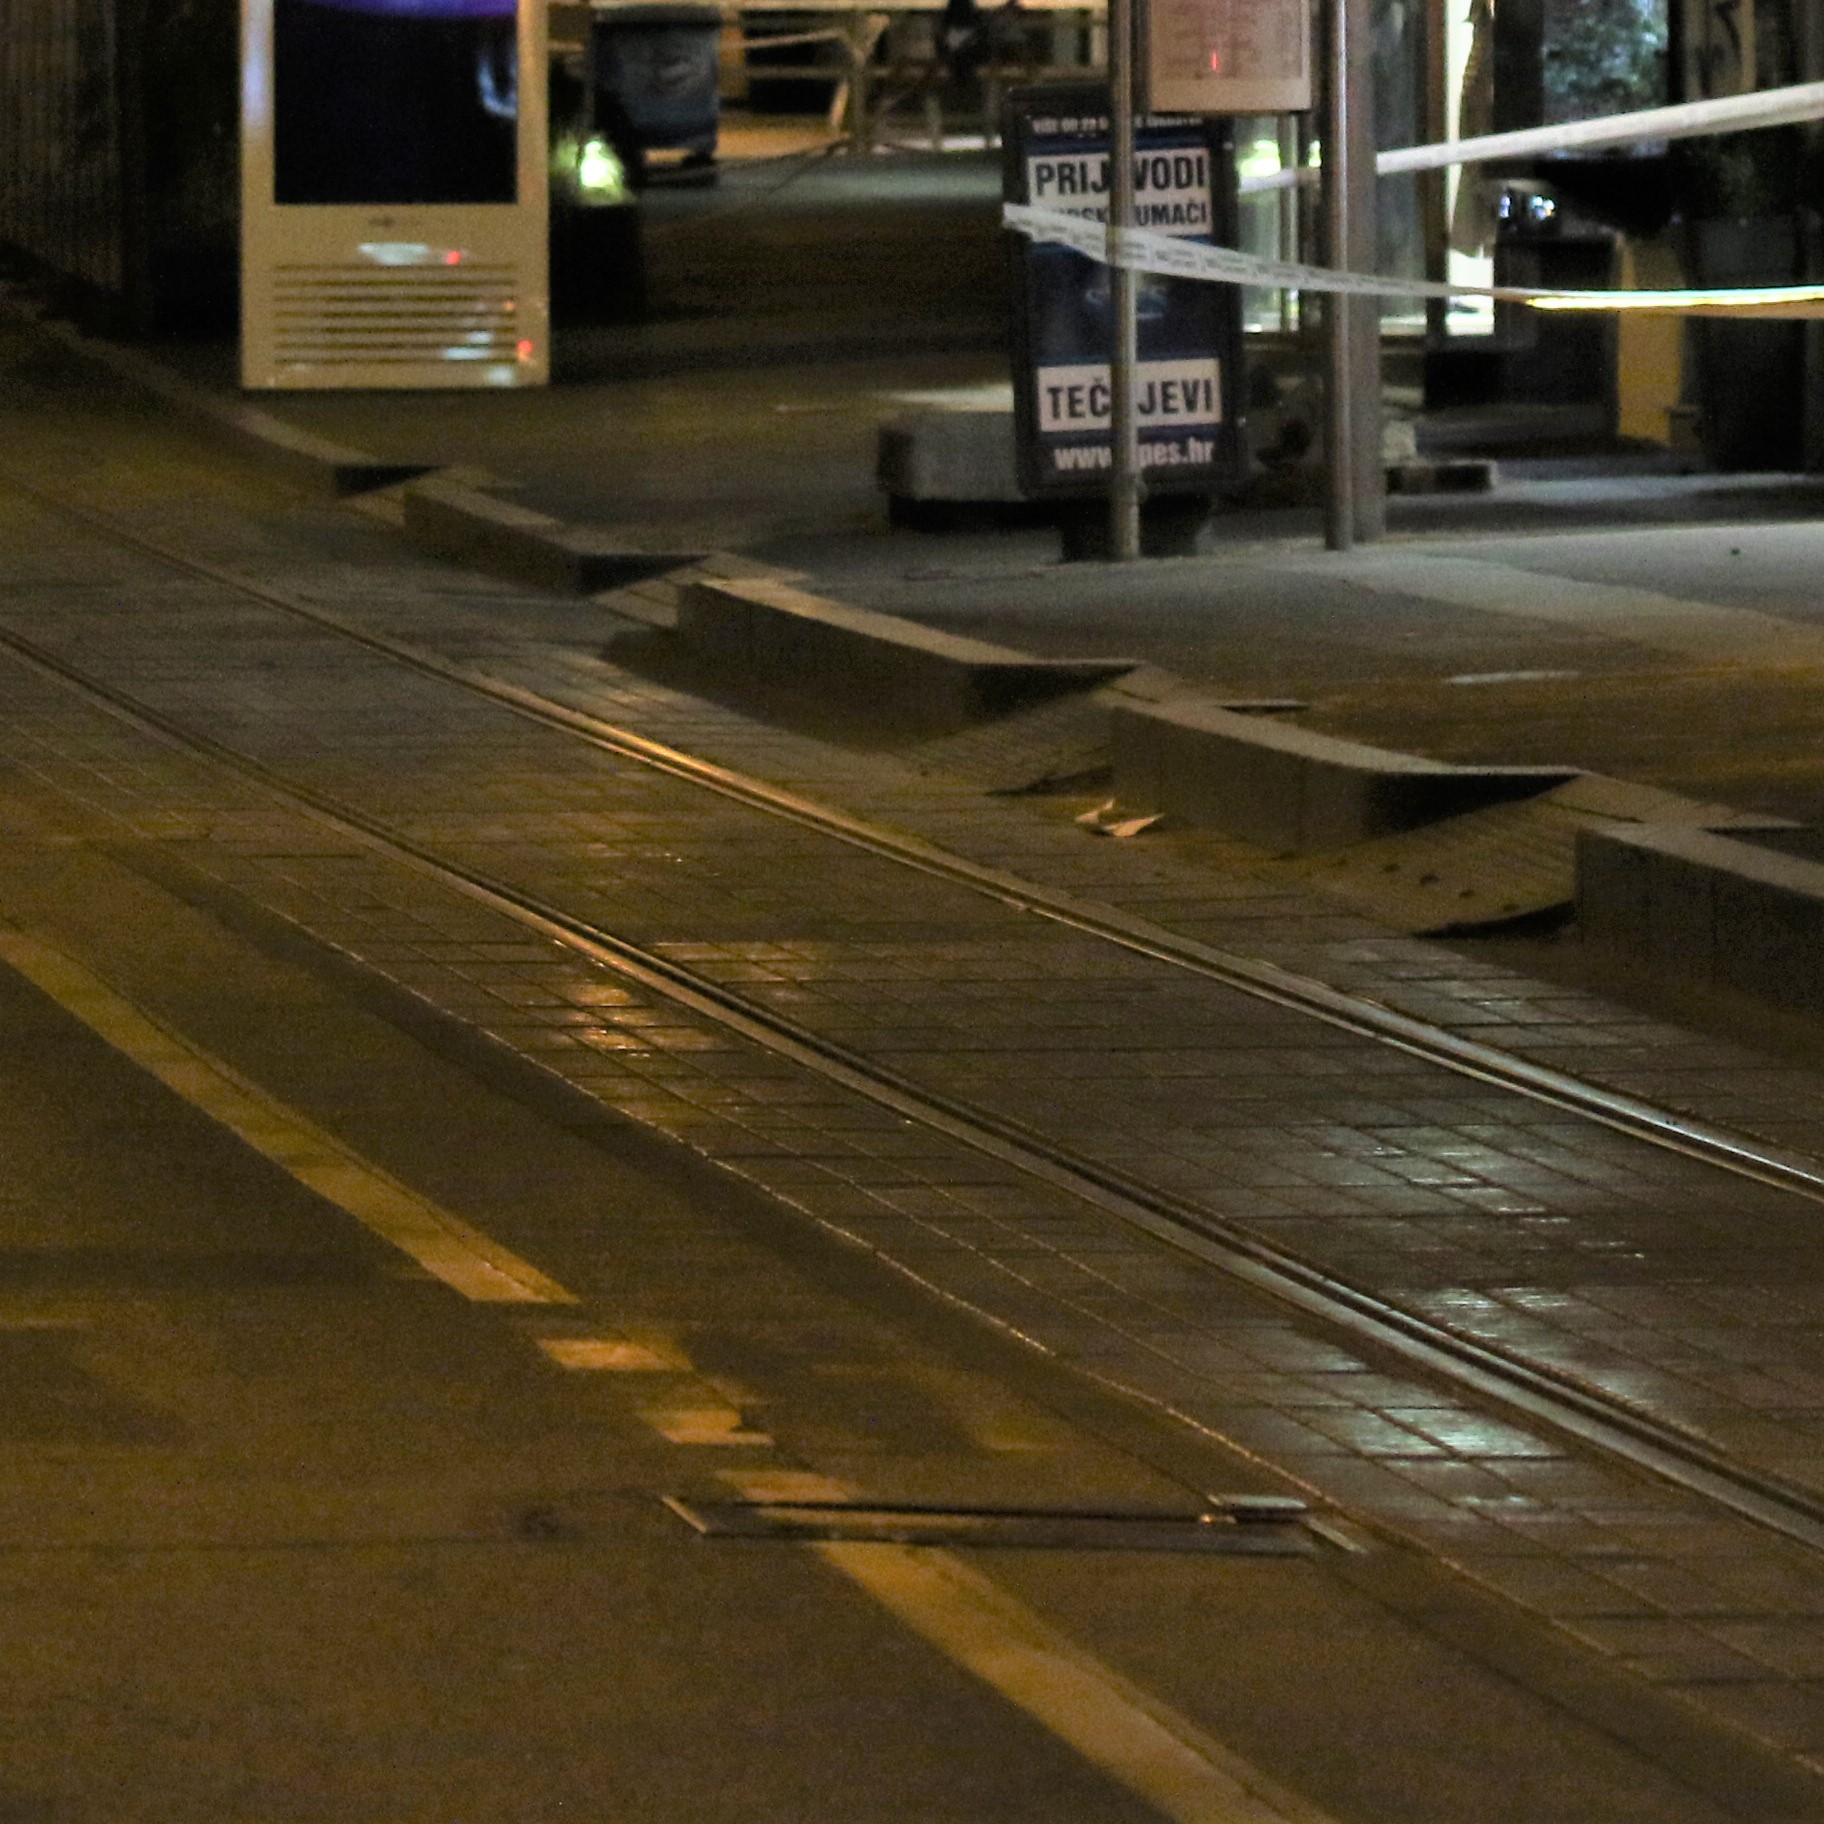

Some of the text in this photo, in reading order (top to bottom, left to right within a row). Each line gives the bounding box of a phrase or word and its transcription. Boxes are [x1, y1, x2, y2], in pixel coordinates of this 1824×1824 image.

[1035, 155, 1205, 196] PRIJVODI
[1134, 200, 1206, 226] UMAČI
[1047, 378, 1212, 420] TEČJEVI
